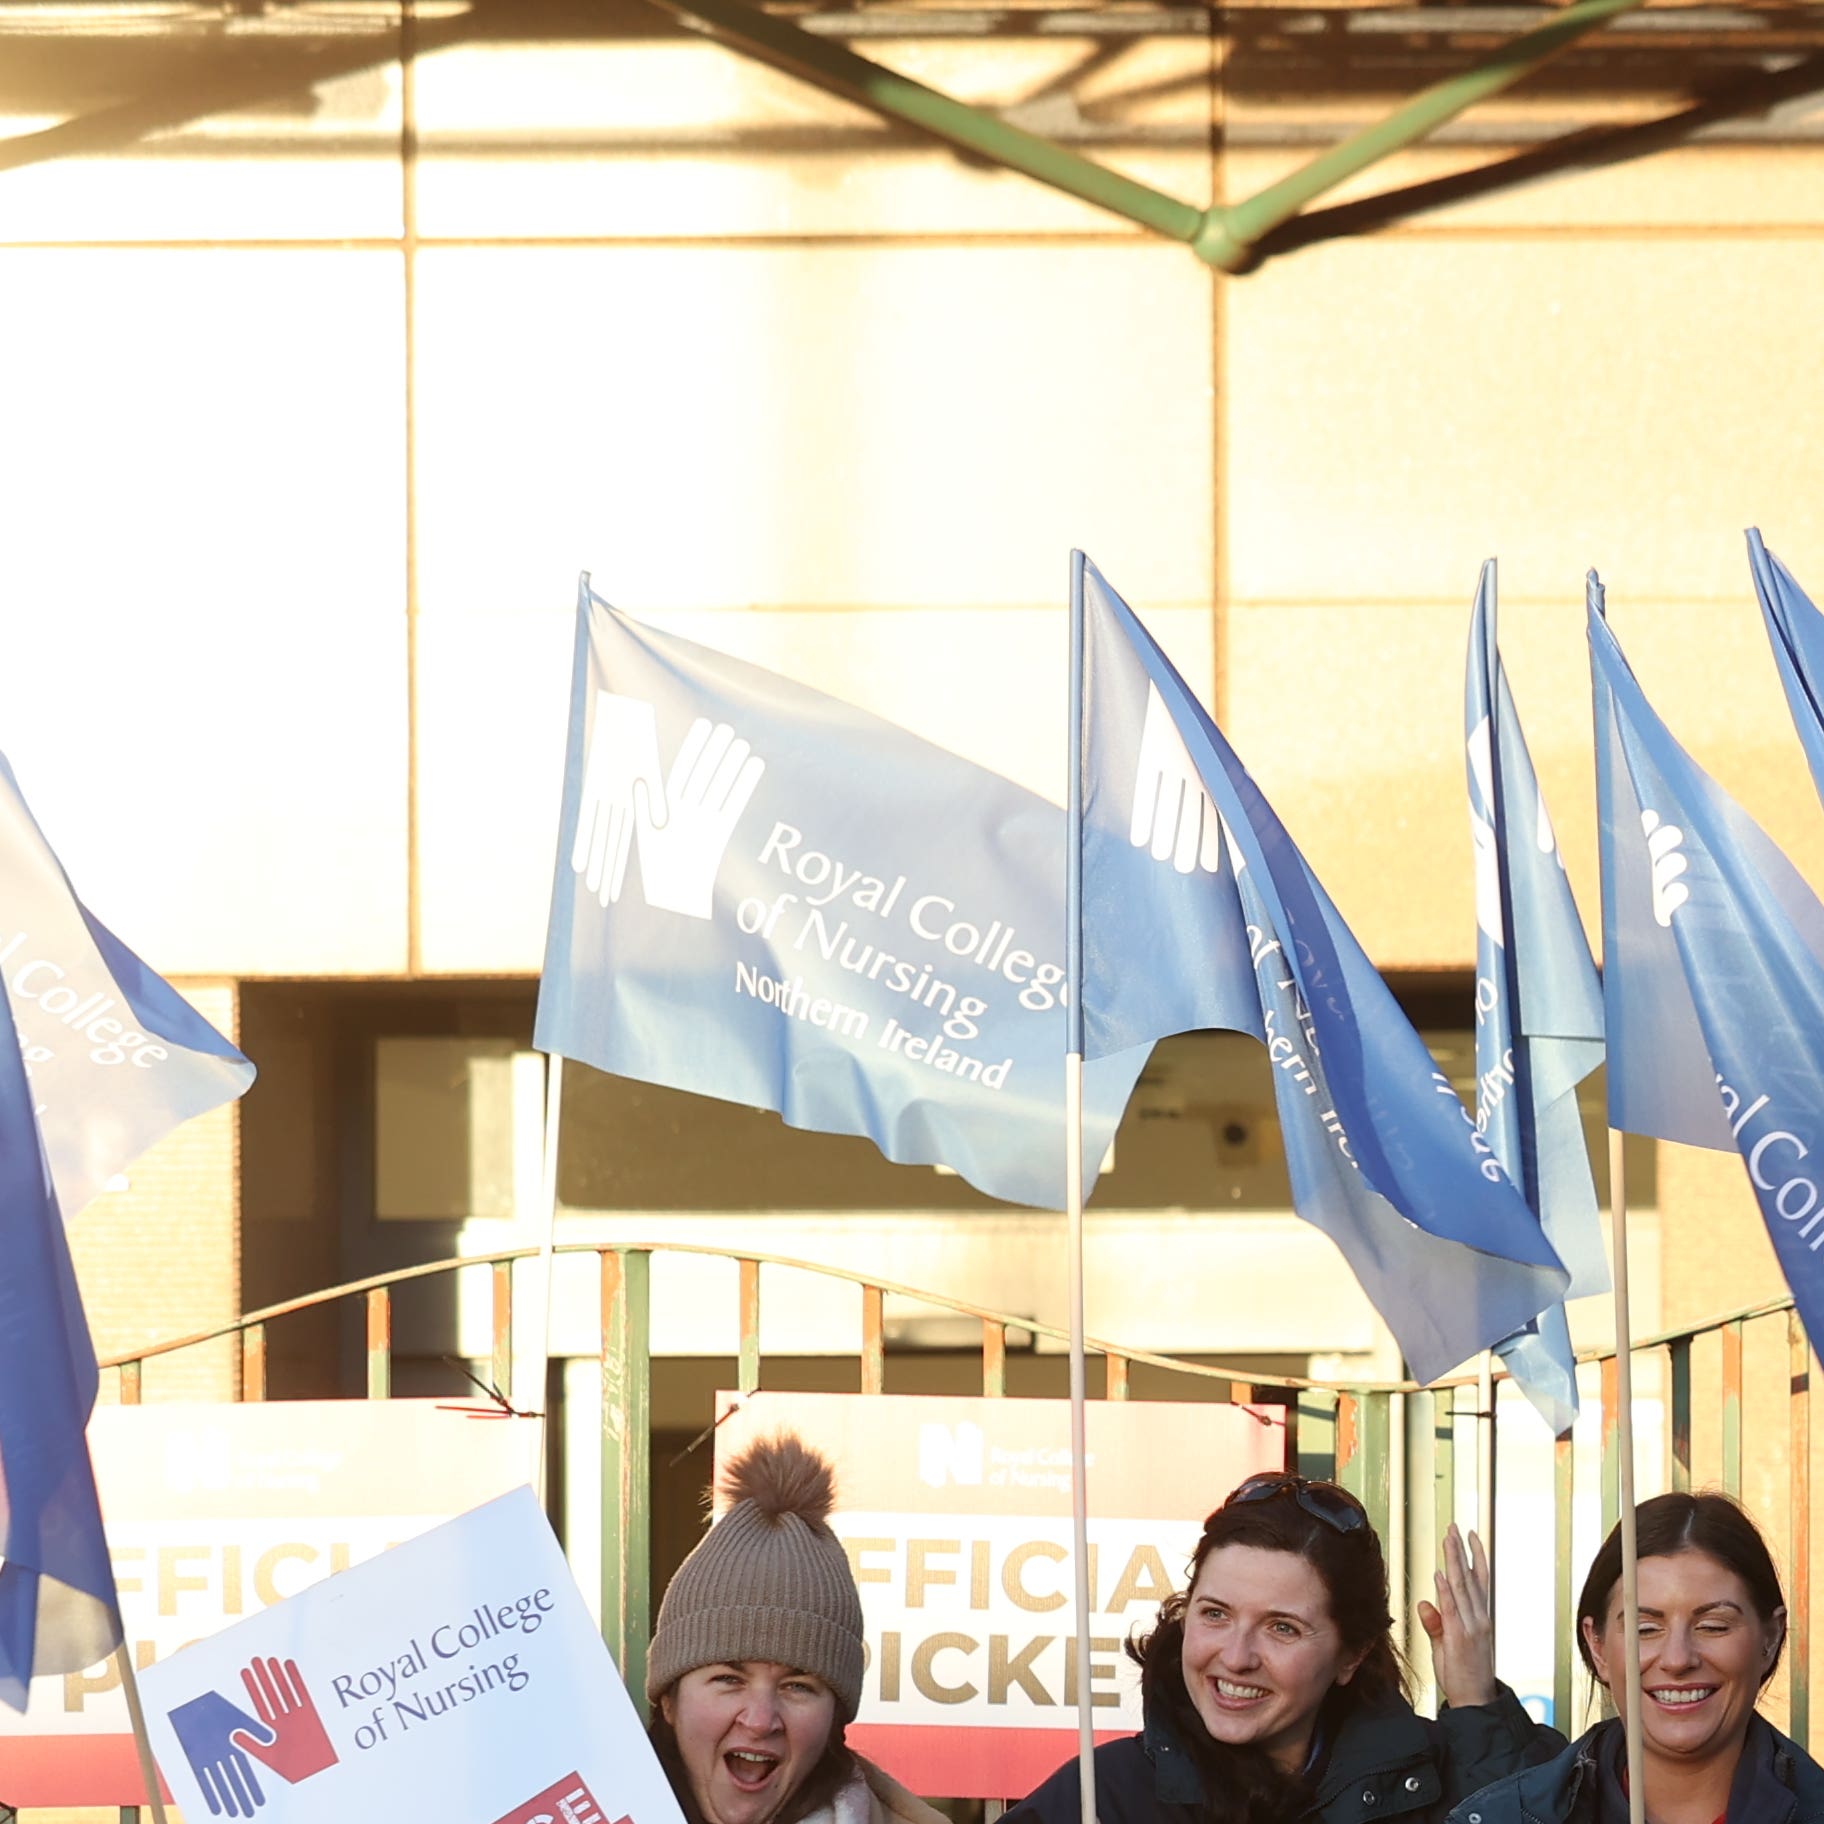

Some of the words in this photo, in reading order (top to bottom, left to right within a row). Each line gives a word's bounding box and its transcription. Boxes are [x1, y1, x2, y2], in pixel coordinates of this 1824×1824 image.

[737, 893, 798, 936] of
[794, 913, 987, 1040] Nursing
[757, 821, 906, 917] Royal
[909, 895, 1067, 1012] Colleg
[12, 960, 168, 1068] College
[735, 962, 868, 1040] Northern
[879, 1019, 1013, 1090] Ireland
[842, 1536, 1178, 1614] FFICIA
[330, 1639, 428, 1713] Royal
[430, 1584, 556, 1660] College
[353, 1709, 389, 1751] of
[396, 1652, 529, 1736] Nursing
[861, 1632, 1121, 1708] ICKE
